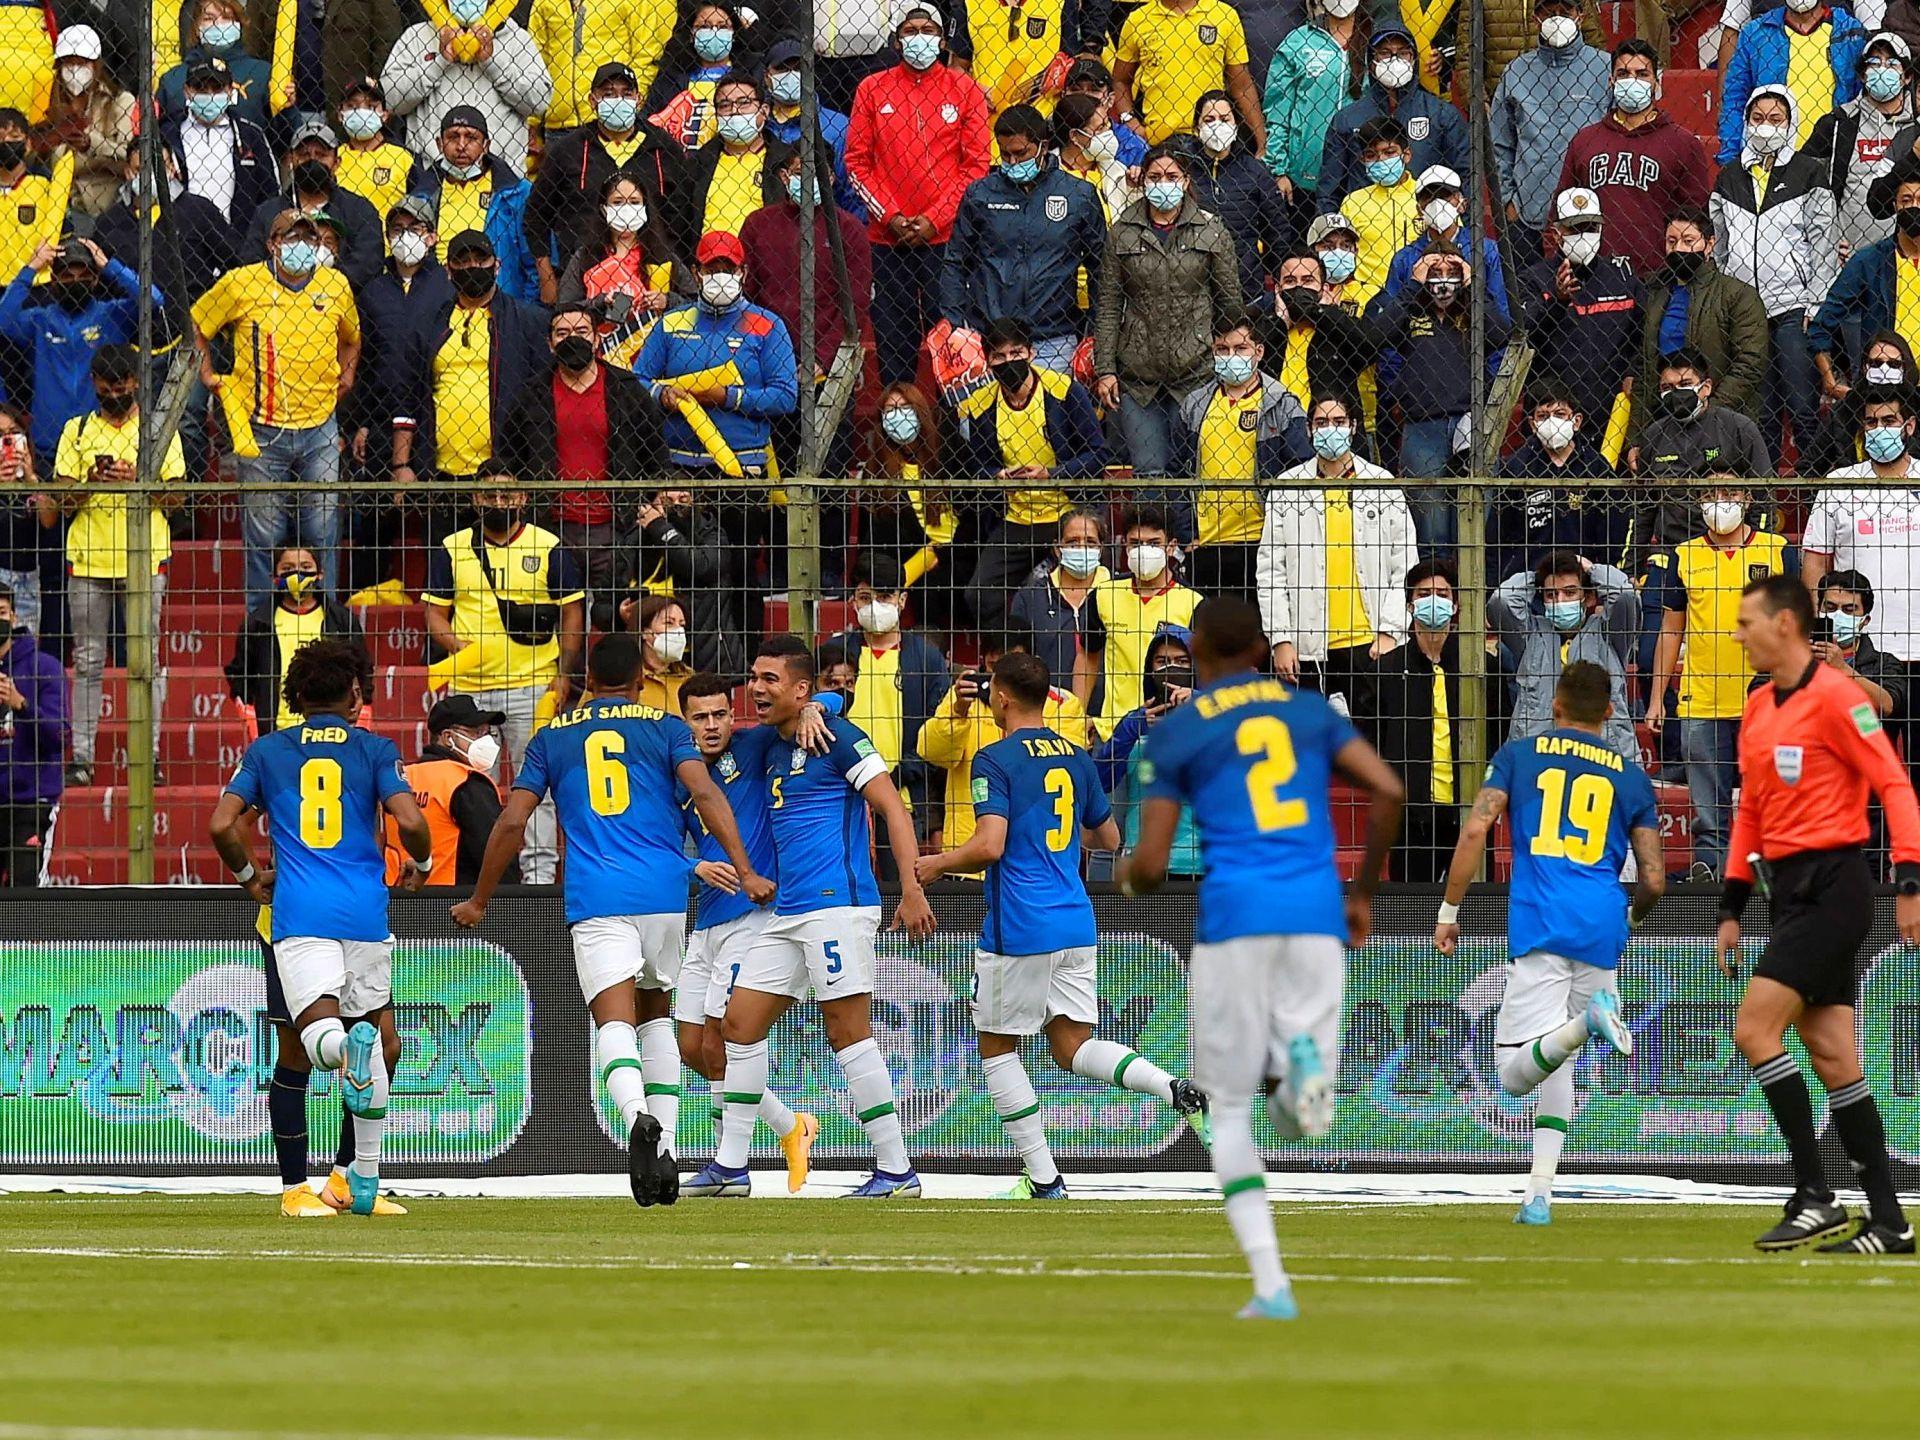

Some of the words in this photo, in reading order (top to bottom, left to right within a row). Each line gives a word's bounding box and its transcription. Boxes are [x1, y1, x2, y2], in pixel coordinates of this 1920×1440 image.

[1589, 152, 1660, 192] GAP
[169, 630, 203, 653] 06
[387, 626, 419, 650] 08
[193, 693, 227, 719] 07
[549, 706, 593, 729] ALEX
[598, 704, 665, 721] SANDRO
[301, 727, 348, 744] FRED
[1021, 738, 1075, 758] T.SILVA
[1535, 736, 1624, 773] RAPHINHA
[584, 729, 631, 817] 6
[1234, 714, 1310, 834] 2
[300, 757, 343, 850] 8
[771, 776, 784, 809] 5
[1043, 767, 1075, 853] 3
[1530, 767, 1615, 866] 19
[1658, 813, 1688, 838] 21
[823, 939, 843, 975] 5
